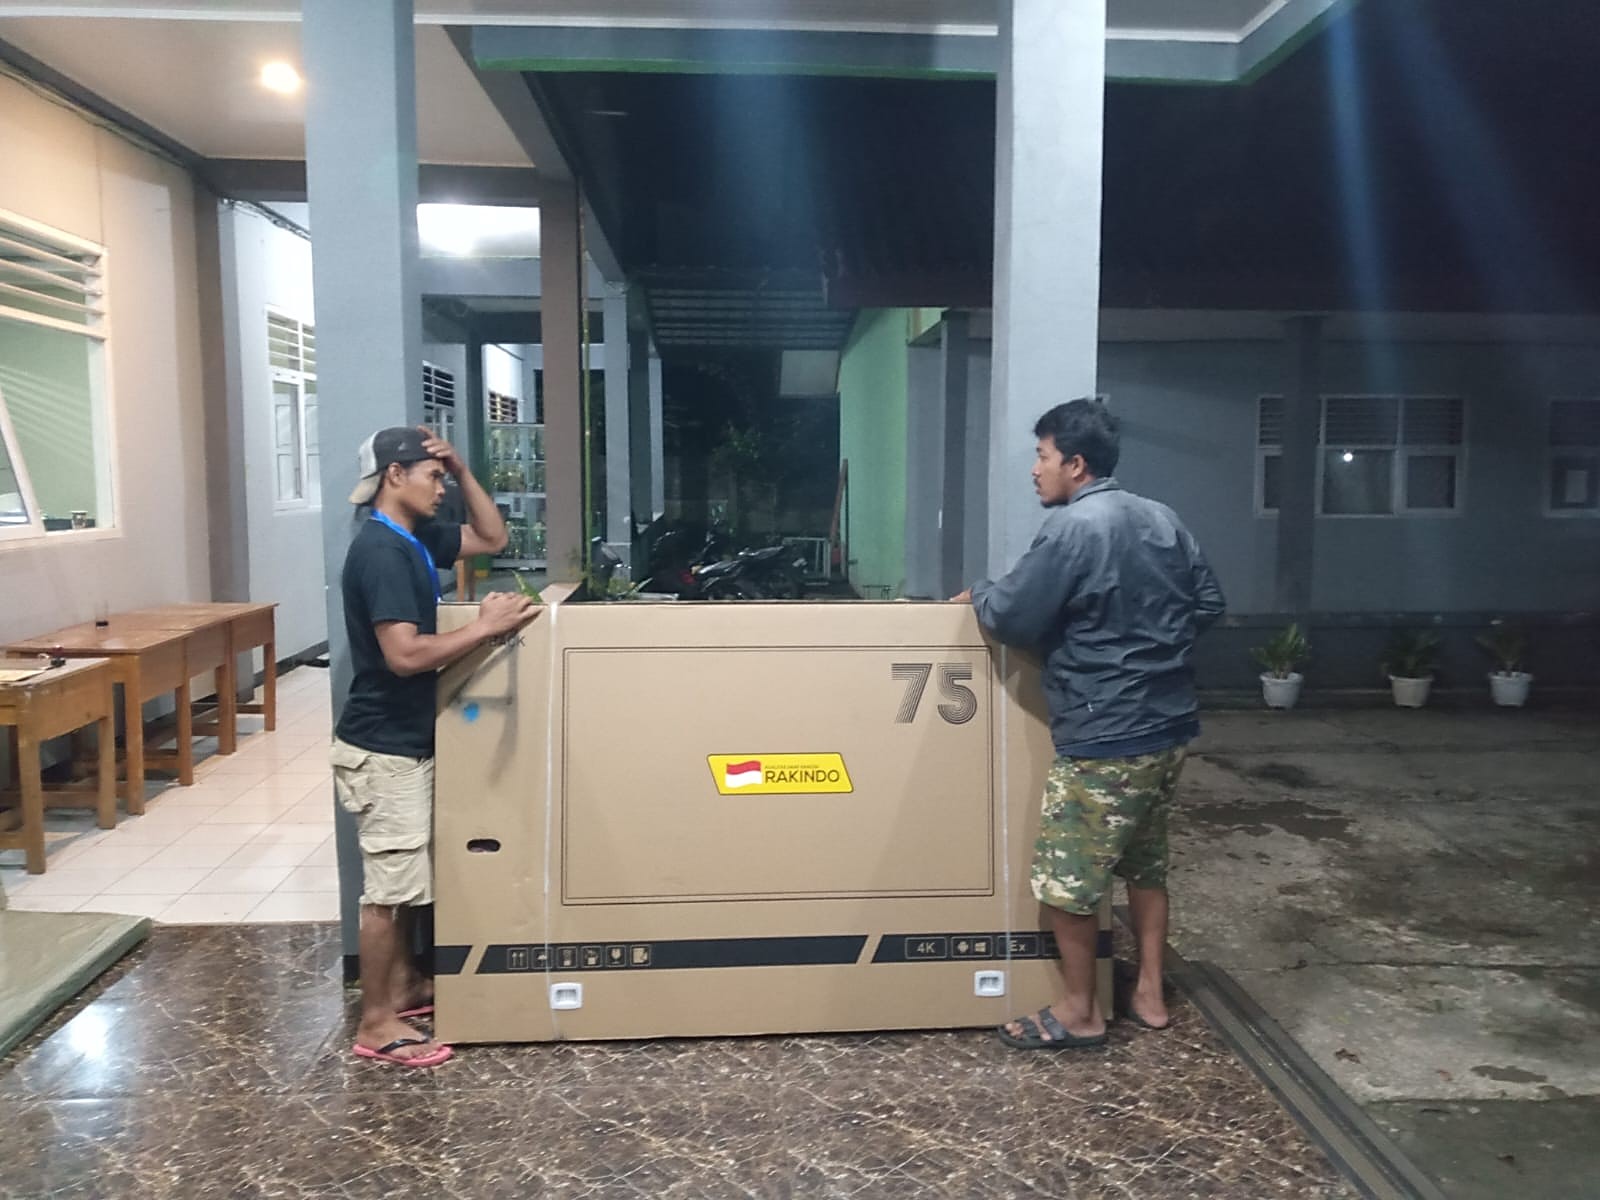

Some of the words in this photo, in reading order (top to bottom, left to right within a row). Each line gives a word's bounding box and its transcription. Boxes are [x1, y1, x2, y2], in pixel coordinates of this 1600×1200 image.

[891, 662, 978, 725] 75
[764, 769, 840, 784] RAKINDO
[917, 941, 936, 954] 4K
